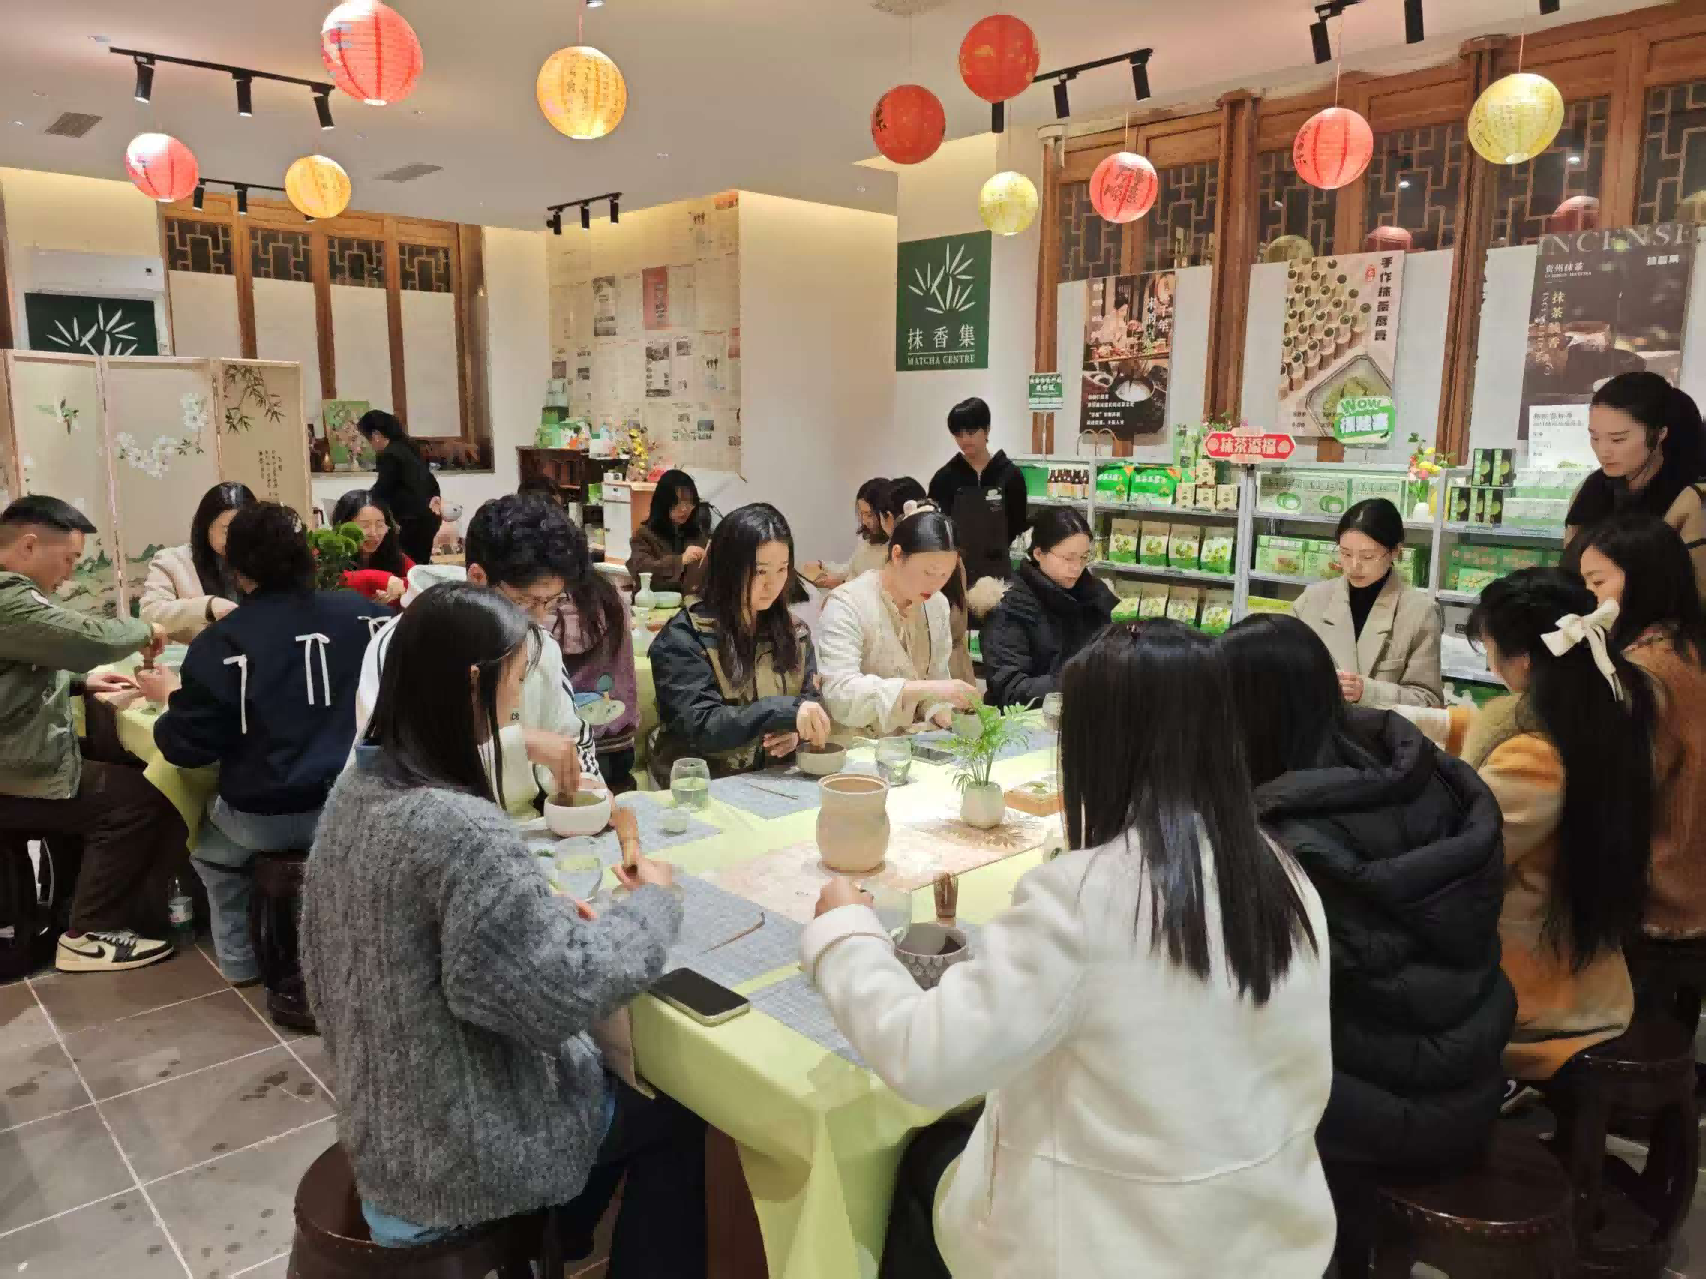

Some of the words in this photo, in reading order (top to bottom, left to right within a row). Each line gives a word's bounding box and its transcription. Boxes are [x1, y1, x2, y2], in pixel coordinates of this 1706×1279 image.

[907, 323, 976, 351] 抹香集
[907, 356, 941, 366] MATCHA
[942, 353, 976, 365] CENTRE
